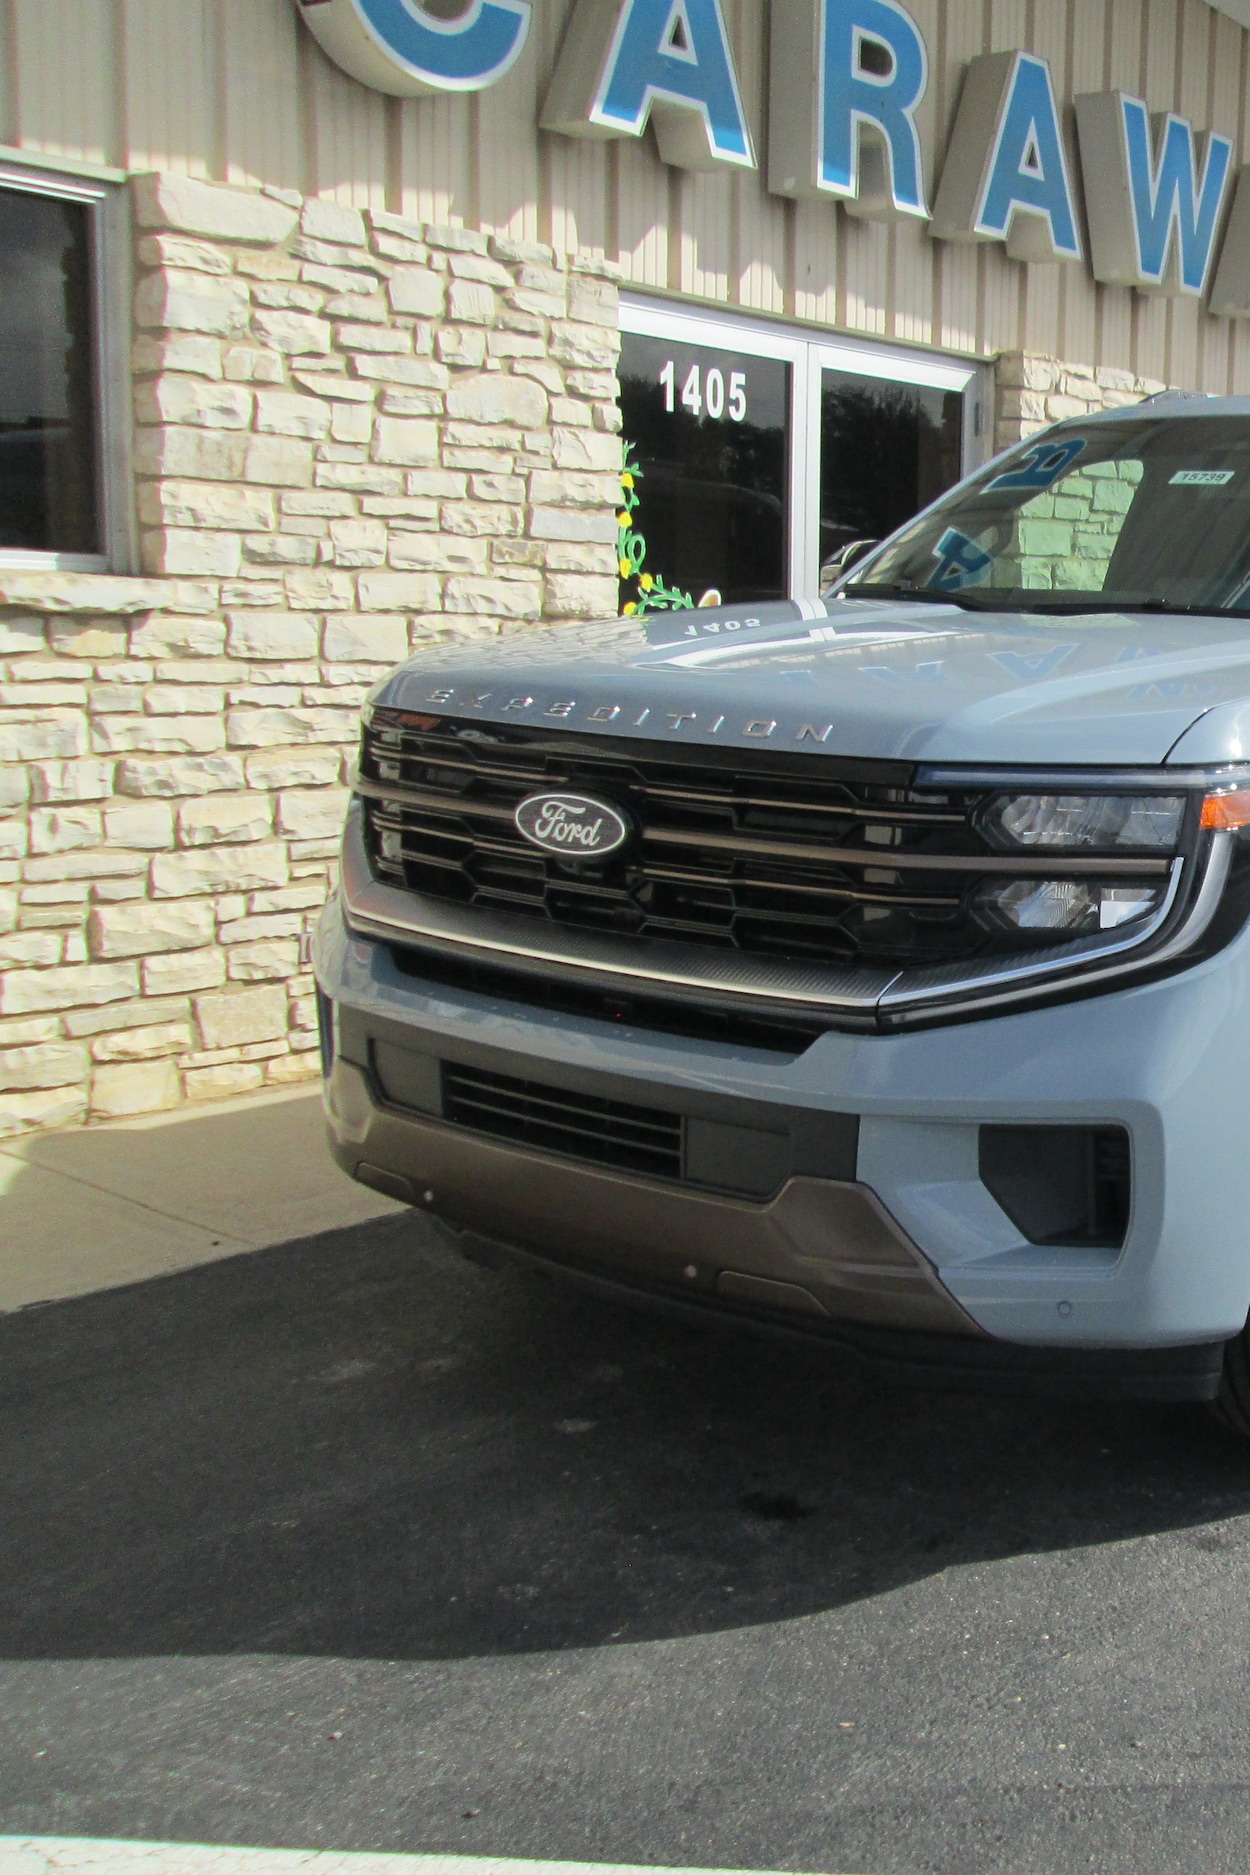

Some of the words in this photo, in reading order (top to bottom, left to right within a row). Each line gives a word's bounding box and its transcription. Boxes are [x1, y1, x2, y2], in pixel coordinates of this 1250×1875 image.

[659, 360, 747, 422] 1405
[425, 689, 834, 743] EXPEDITION
[534, 801, 603, 846] Ford
